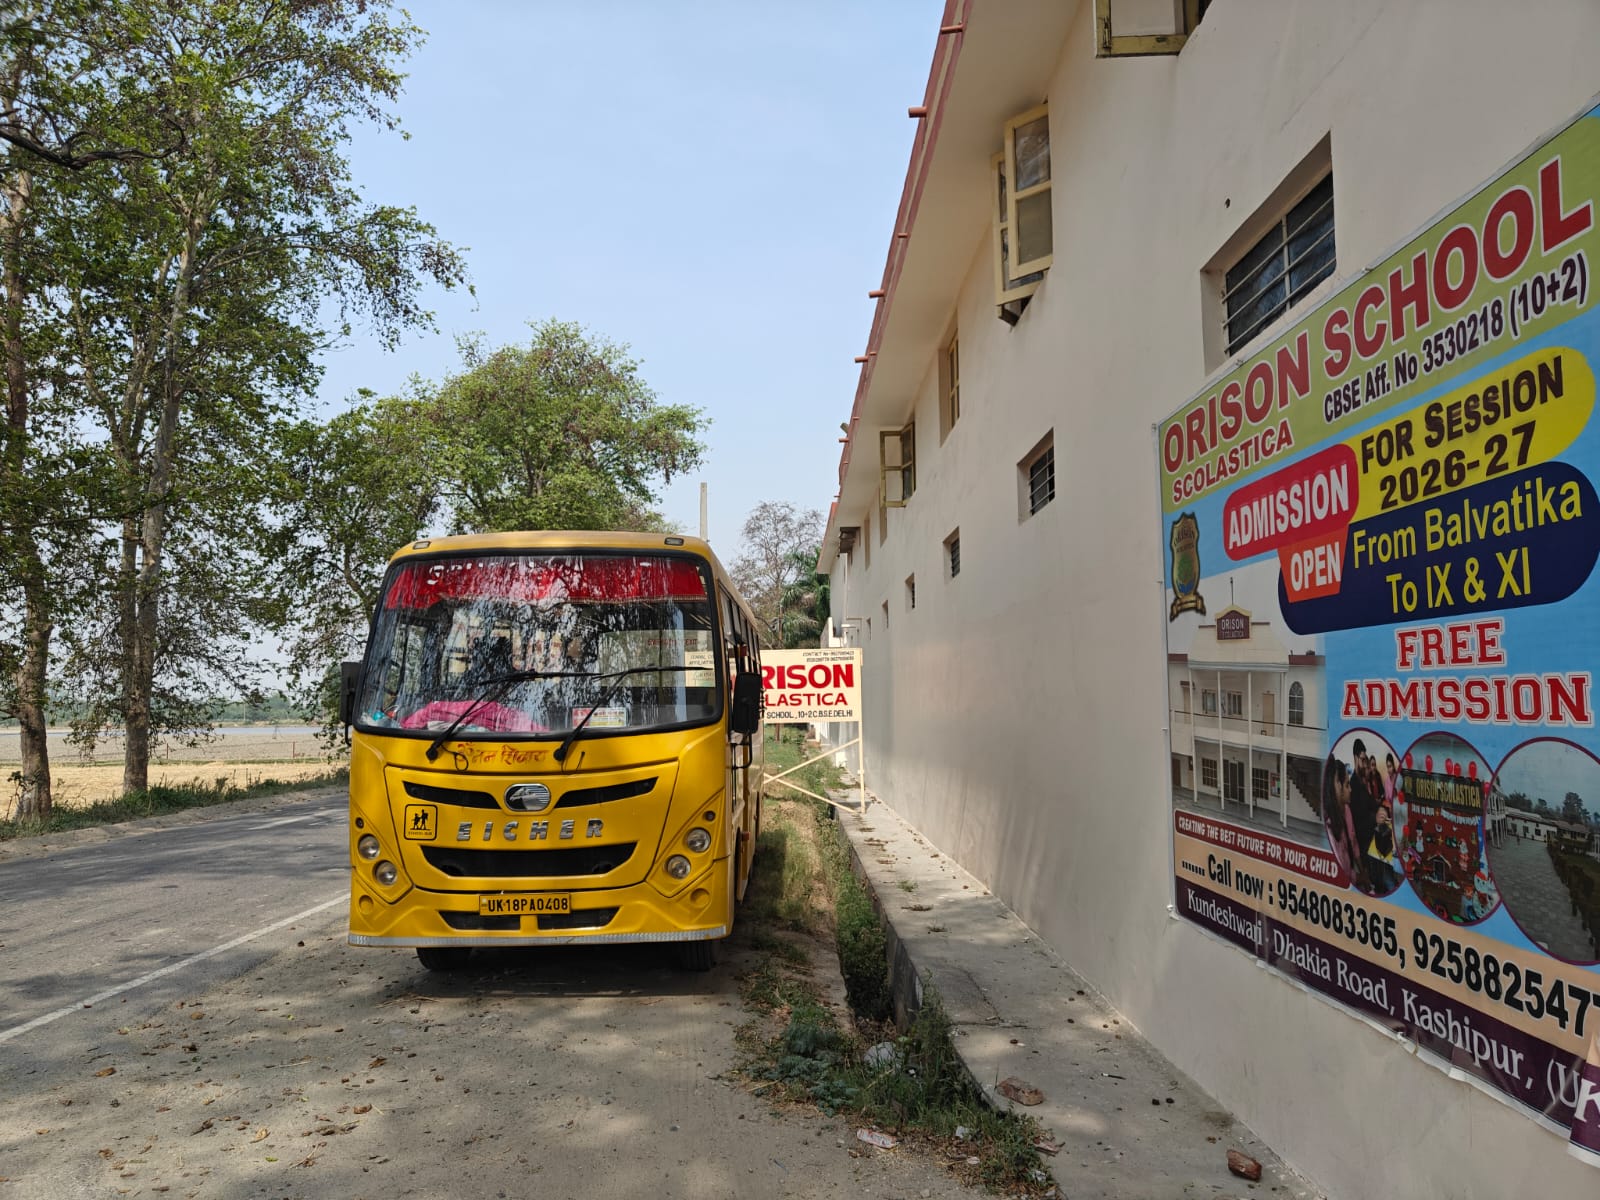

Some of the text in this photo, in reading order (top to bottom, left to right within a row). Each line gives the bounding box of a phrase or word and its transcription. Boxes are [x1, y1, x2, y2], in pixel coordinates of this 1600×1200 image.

[1164, 157, 1592, 473] ORISON SCHOOL
[1324, 253, 1588, 423] CBSE Aff. No 3530218 (10+2)
[1361, 356, 1564, 473] FOR SESSION
[1172, 420, 1293, 503] SCOLASTICA
[1380, 421, 1537, 510] 2026-27
[1228, 464, 1349, 550] ADMISSION
[1353, 475, 1582, 569] From Balvatika
[1290, 542, 1341, 592] OPEN
[1386, 547, 1532, 614] To IX & XI
[1221, 618, 1244, 630] ORISON
[1397, 620, 1505, 668] FREE
[760, 664, 854, 689] RISON
[765, 693, 848, 706] LASTICA
[1343, 673, 1592, 725] ADMISSION
[456, 818, 604, 841] EICHER
[1178, 816, 1339, 879] CREATING THE BEST FUTURE FOR YOUR CHILD
[488, 898, 568, 912] UK18PA0408
[1187, 888, 1262, 946] Kundeshwari
[1273, 929, 1332, 982] Dhakia
[1337, 958, 1396, 1017] Road,
[1208, 854, 1232, 887] Call
[1235, 869, 1264, 896] now
[1278, 879, 1405, 969] 9548083365,
[1413, 928, 1600, 1037] 925882547
